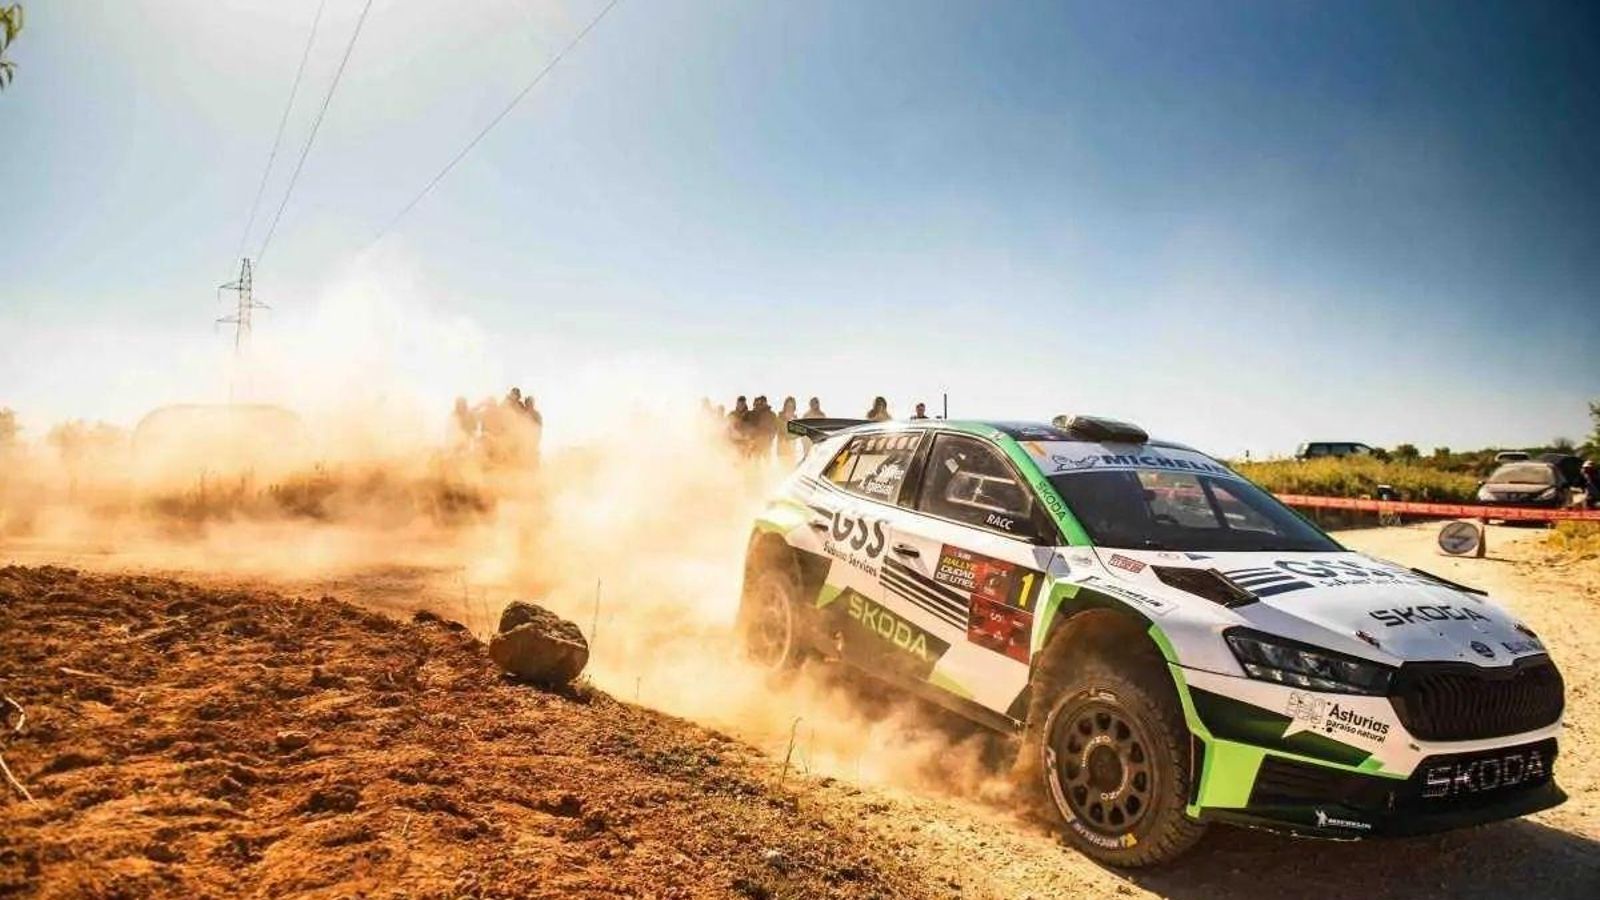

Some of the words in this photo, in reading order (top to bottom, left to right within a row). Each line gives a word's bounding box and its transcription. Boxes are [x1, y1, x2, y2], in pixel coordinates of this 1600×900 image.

[1101, 454, 1230, 476] MICHELIN
[1036, 480, 1066, 521] SKODA
[985, 513, 1014, 531] RACC
[832, 511, 887, 559] GSS
[848, 552, 877, 578] Services
[940, 564, 976, 580] CIUDAD
[942, 556, 978, 573] RALLYE
[936, 571, 950, 581] DE
[950, 574, 977, 590] UTIEL
[1018, 572, 1035, 608] 1
[848, 594, 928, 662] SKODA
[1369, 604, 1492, 628] SKODA
[1328, 703, 1391, 735] Asturias
[1356, 728, 1386, 744] natural
[1421, 750, 1545, 798] SKODA
